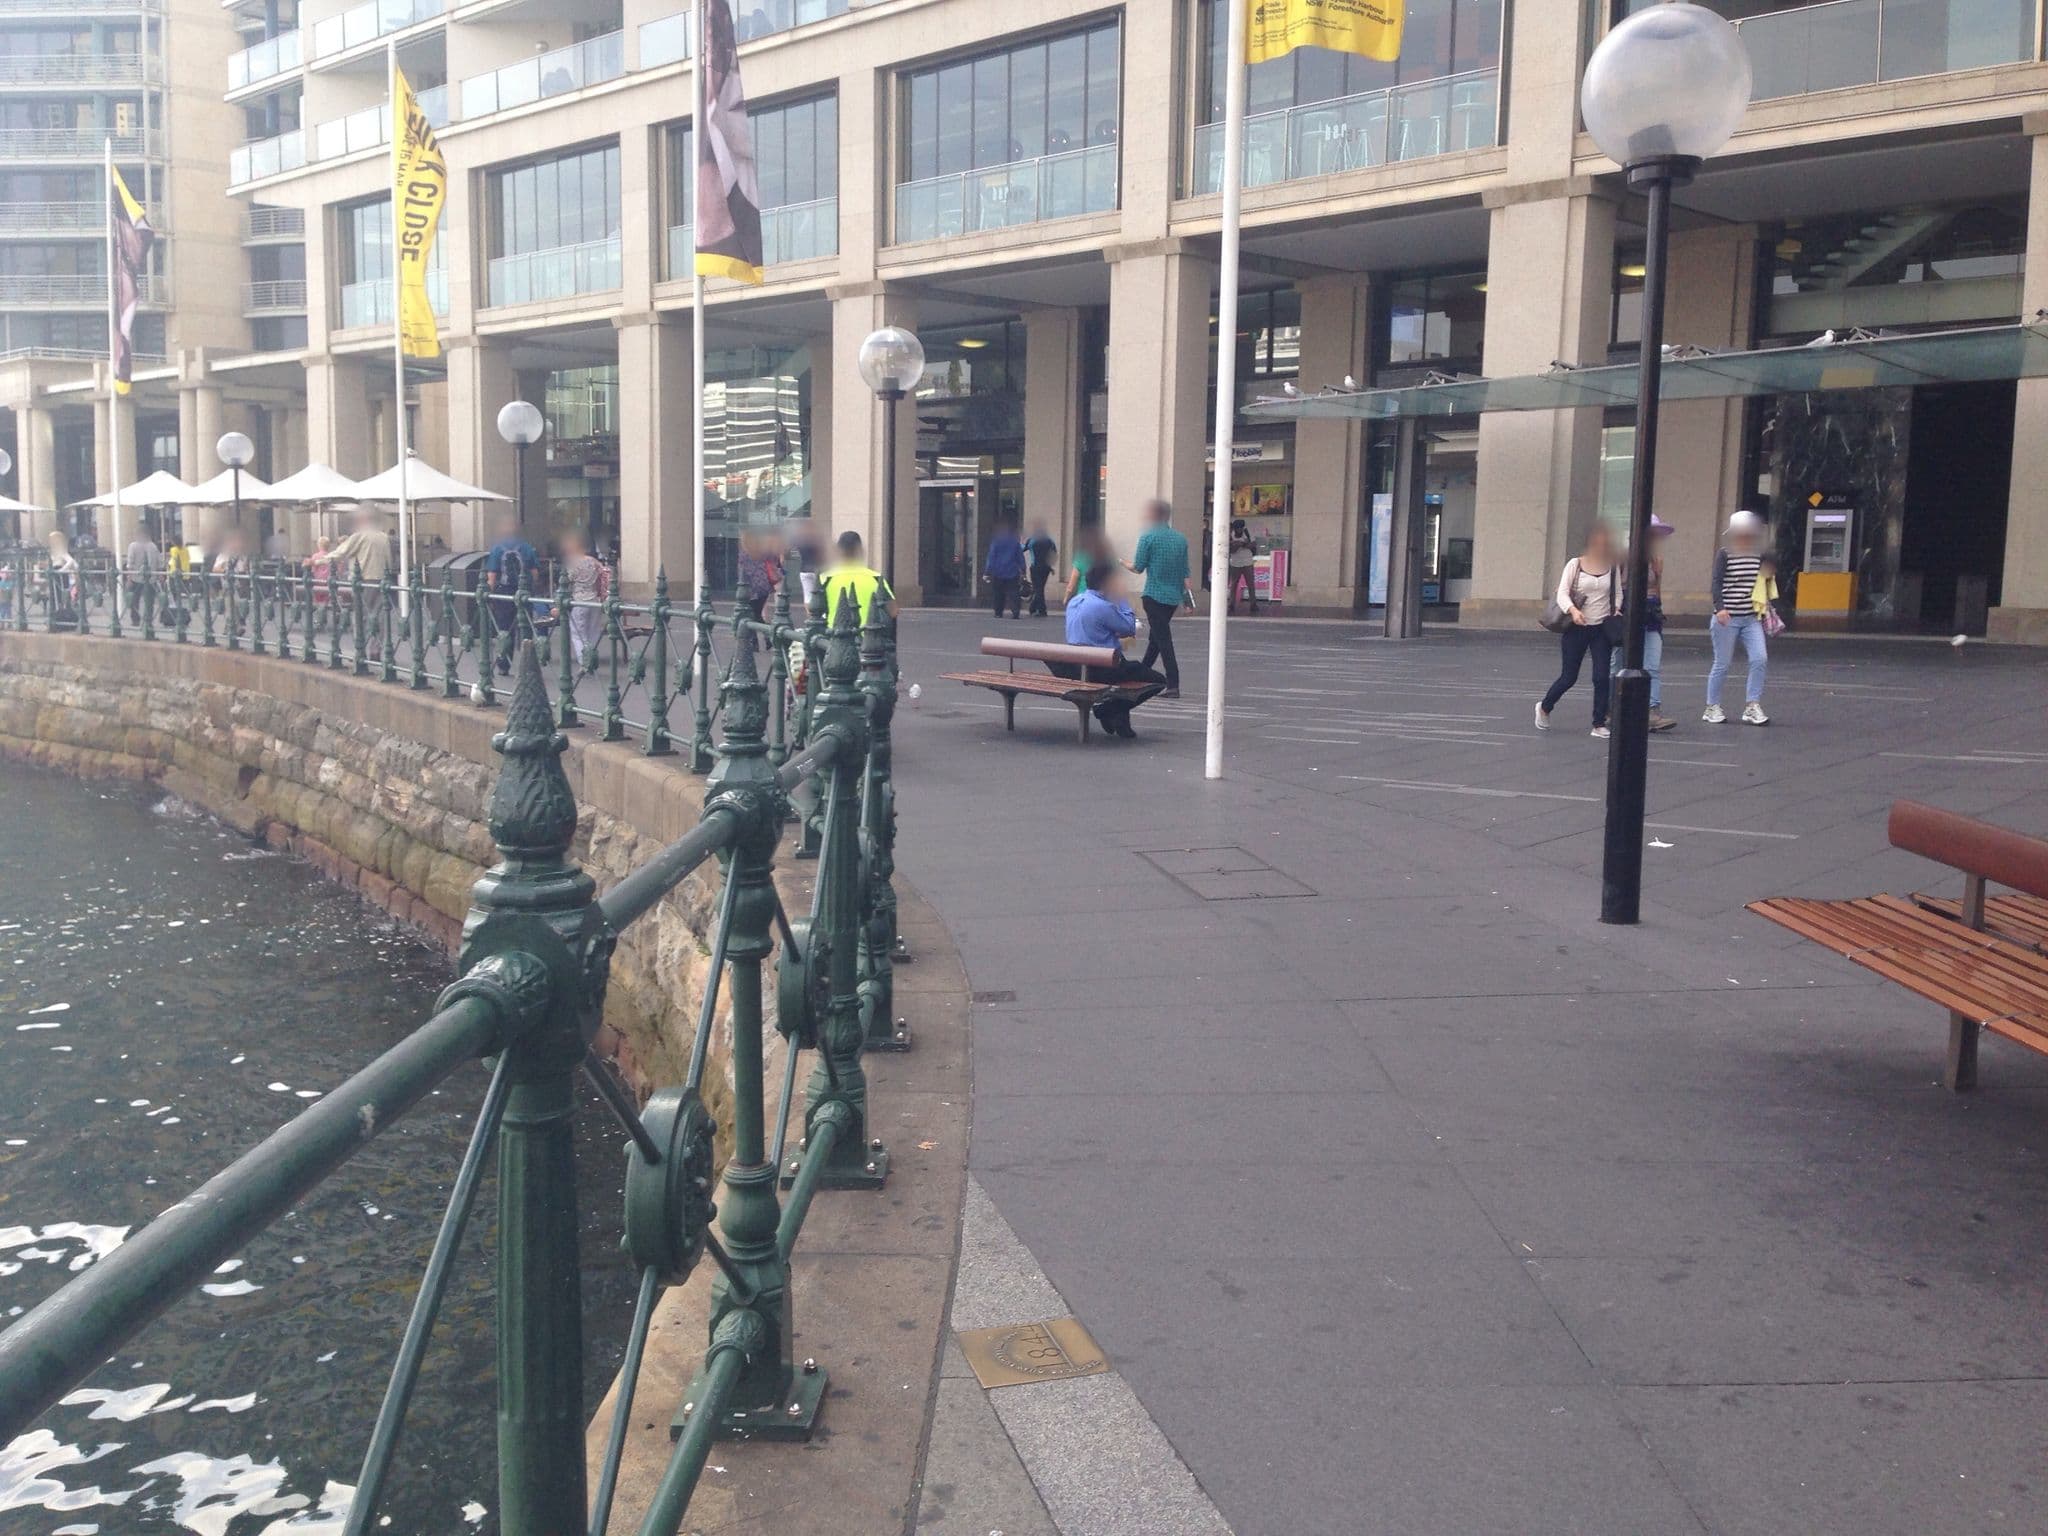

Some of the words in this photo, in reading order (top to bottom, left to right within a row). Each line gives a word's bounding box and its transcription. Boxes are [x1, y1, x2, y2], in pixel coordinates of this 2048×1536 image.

[1328, 3, 1364, 16] Foreshore
[1366, 9, 1395, 25] Authority
[1357, 1, 1384, 15] Harbour
[401, 181, 439, 262] CLOSE
[1011, 1323, 1069, 1368] 1844
